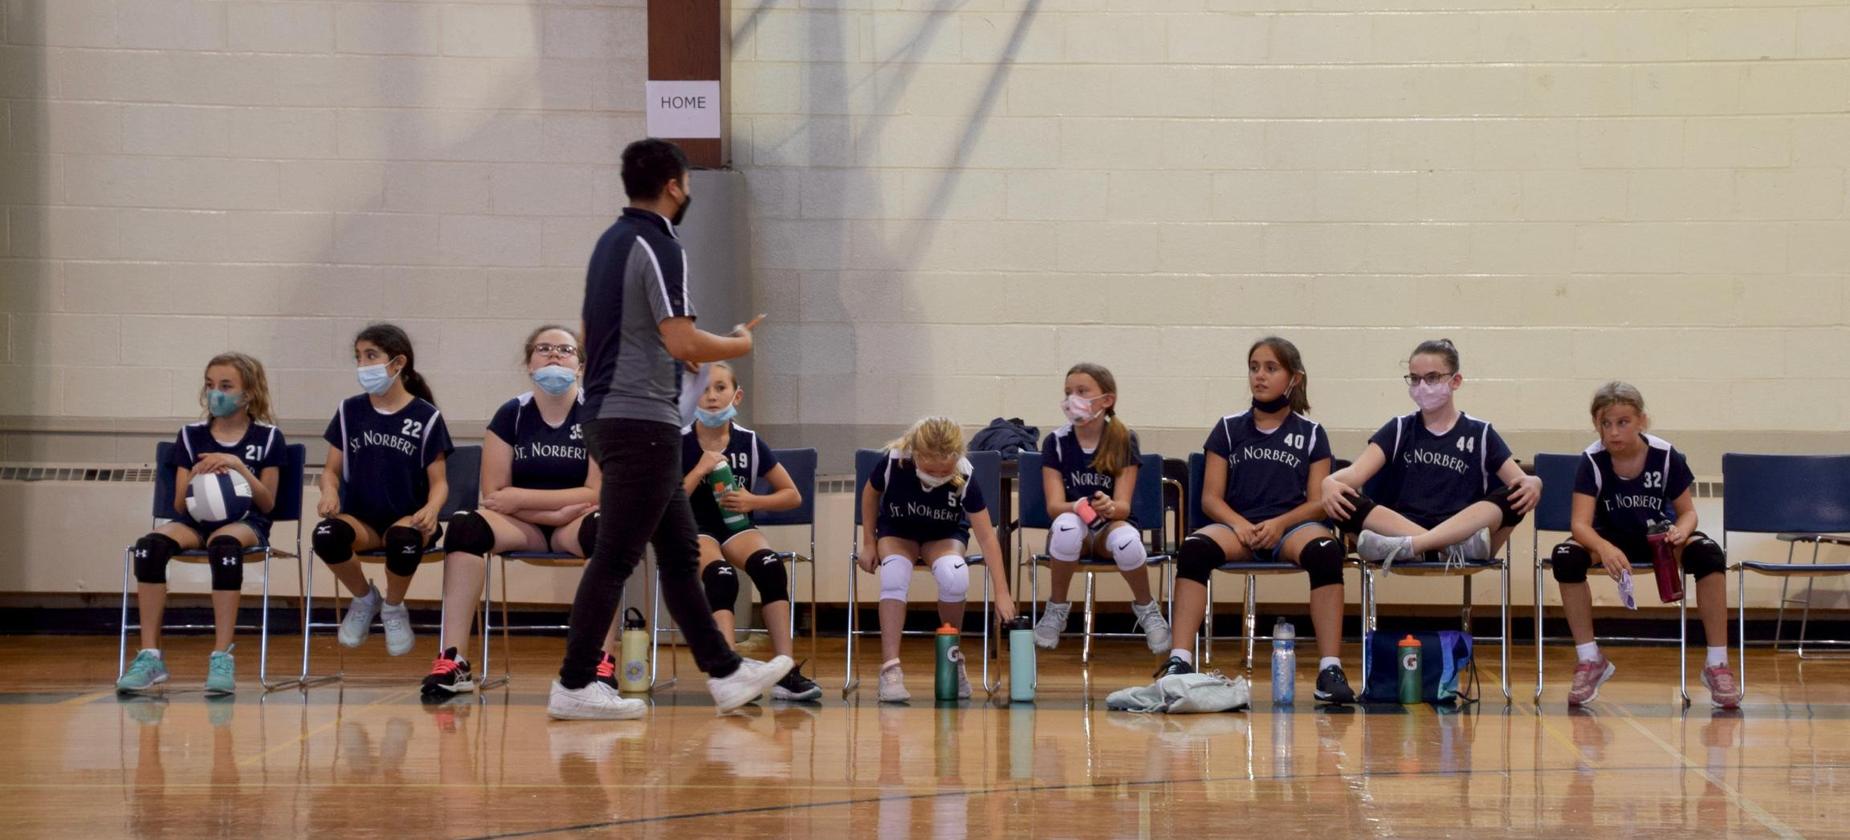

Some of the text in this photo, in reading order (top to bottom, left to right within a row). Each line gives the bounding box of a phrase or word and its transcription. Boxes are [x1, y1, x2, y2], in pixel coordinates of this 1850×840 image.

[661, 96, 706, 109] HOME
[401, 418, 422, 439] 22
[363, 429, 417, 456] NORBERT
[514, 441, 587, 460] ST. NORBERT
[1283, 433, 1305, 450] 40
[1456, 435, 1475, 453] 44
[245, 444, 262, 462] 21
[730, 452, 748, 469] 19
[1244, 445, 1302, 468] NORBERT
[1414, 448, 1470, 475] NORBERT
[1643, 471, 1662, 488] 32
[889, 501, 960, 521] ST. NORBERT
[1403, 654, 1418, 671] G
